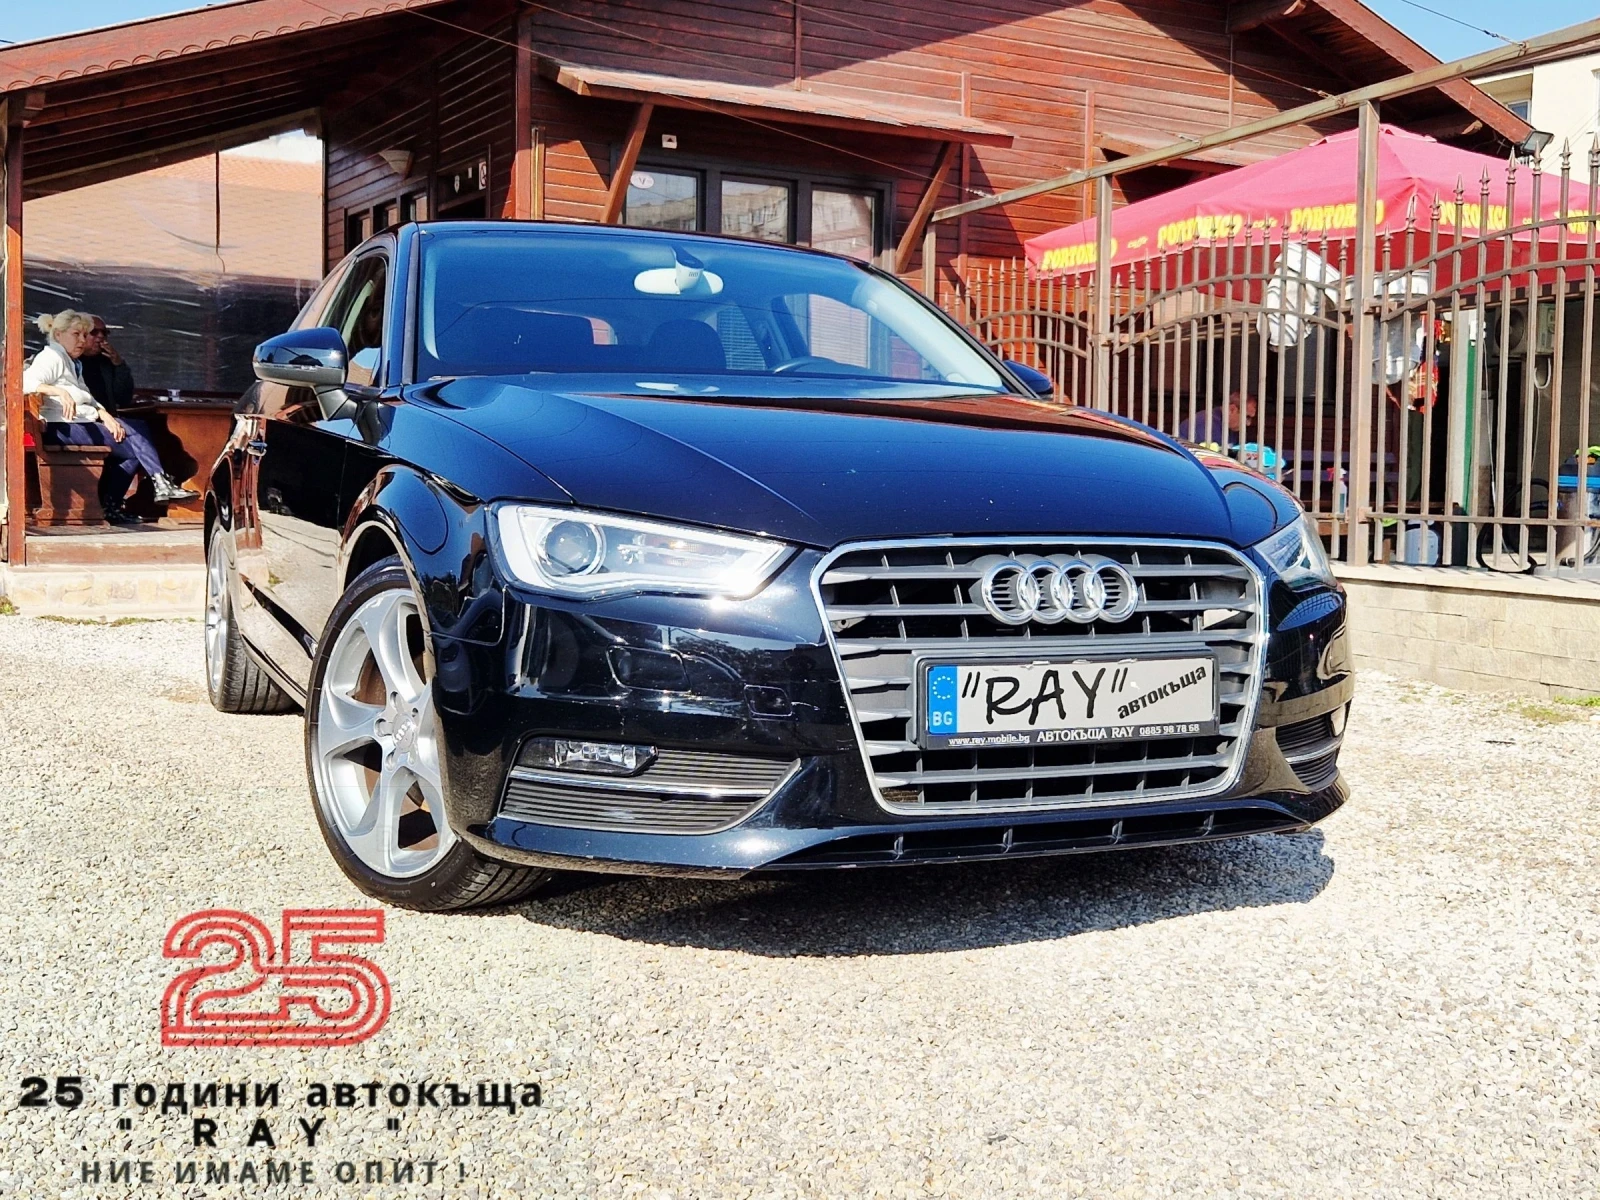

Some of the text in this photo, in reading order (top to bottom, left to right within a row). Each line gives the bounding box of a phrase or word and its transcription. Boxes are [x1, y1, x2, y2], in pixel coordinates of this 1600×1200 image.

[1041, 237, 1118, 271] PORTORO
[1288, 199, 1385, 233] PORTORO
[1117, 665, 1208, 720] автокъща
[932, 711, 953, 726] BG
[948, 733, 1031, 747] www.ray.mobile.bg
[1036, 727, 1108, 743] АВТОКЪЩА
[1111, 726, 1135, 739] RAY
[1139, 726, 1162, 737] 0885
[1163, 725, 1175, 735] 98
